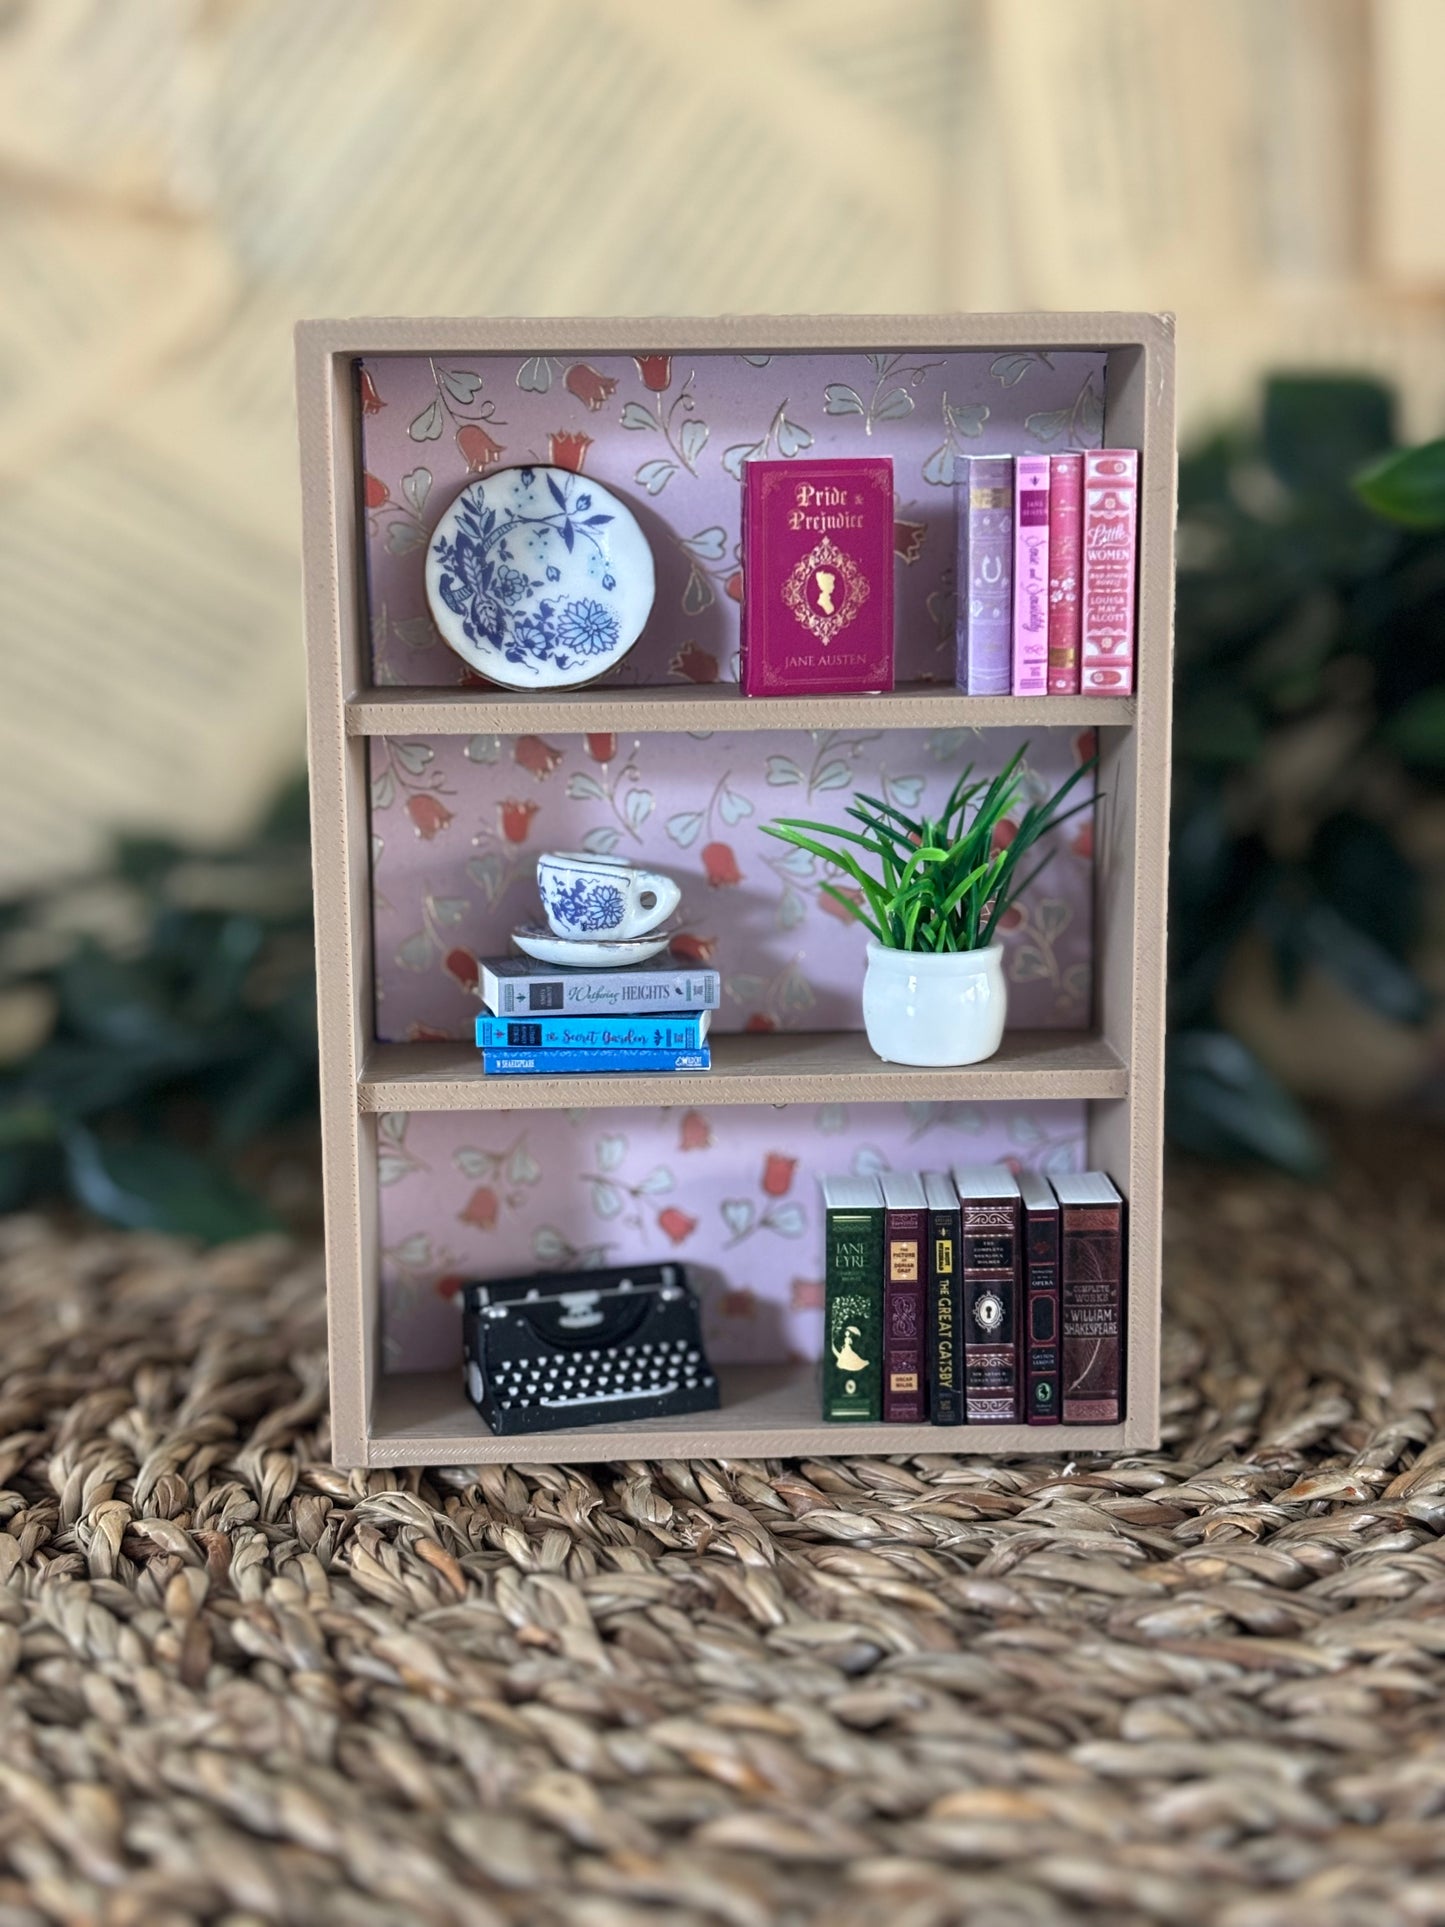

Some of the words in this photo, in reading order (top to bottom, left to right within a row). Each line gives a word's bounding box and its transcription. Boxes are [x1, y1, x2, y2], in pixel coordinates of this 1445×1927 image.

[795, 480, 848, 508] Pride
[854, 494, 864, 505] &
[789, 508, 865, 533] Prejudice
[1087, 522, 1130, 547] Little
[1087, 549, 1130, 561] WOMEN
[1090, 596, 1125, 605] LOUISA
[1098, 605, 1117, 613] MAY
[1090, 613, 1125, 623] ALCOTT
[784, 655, 815, 668] JANE
[818, 653, 867, 666] AUSTEN
[622, 984, 670, 1000] HEIGHTS
[563, 1028, 599, 1044] Secret
[602, 1028, 648, 1044] Garden
[502, 1059, 535, 1069] SHAKESPEARE
[836, 1242, 866, 1255] JANE
[835, 1255, 867, 1268] EYRE
[939, 1279, 950, 1295] THE
[1031, 1279, 1054, 1287] OPERA
[1073, 1285, 1110, 1293] COMPLETE
[1075, 1293, 1109, 1302] WORKS
[938, 1297, 952, 1338] GREAT
[1071, 1309, 1112, 1322] WILLIAM
[1064, 1322, 1119, 1336] SHAKESPEARE
[938, 1341, 952, 1389] GATSBY
